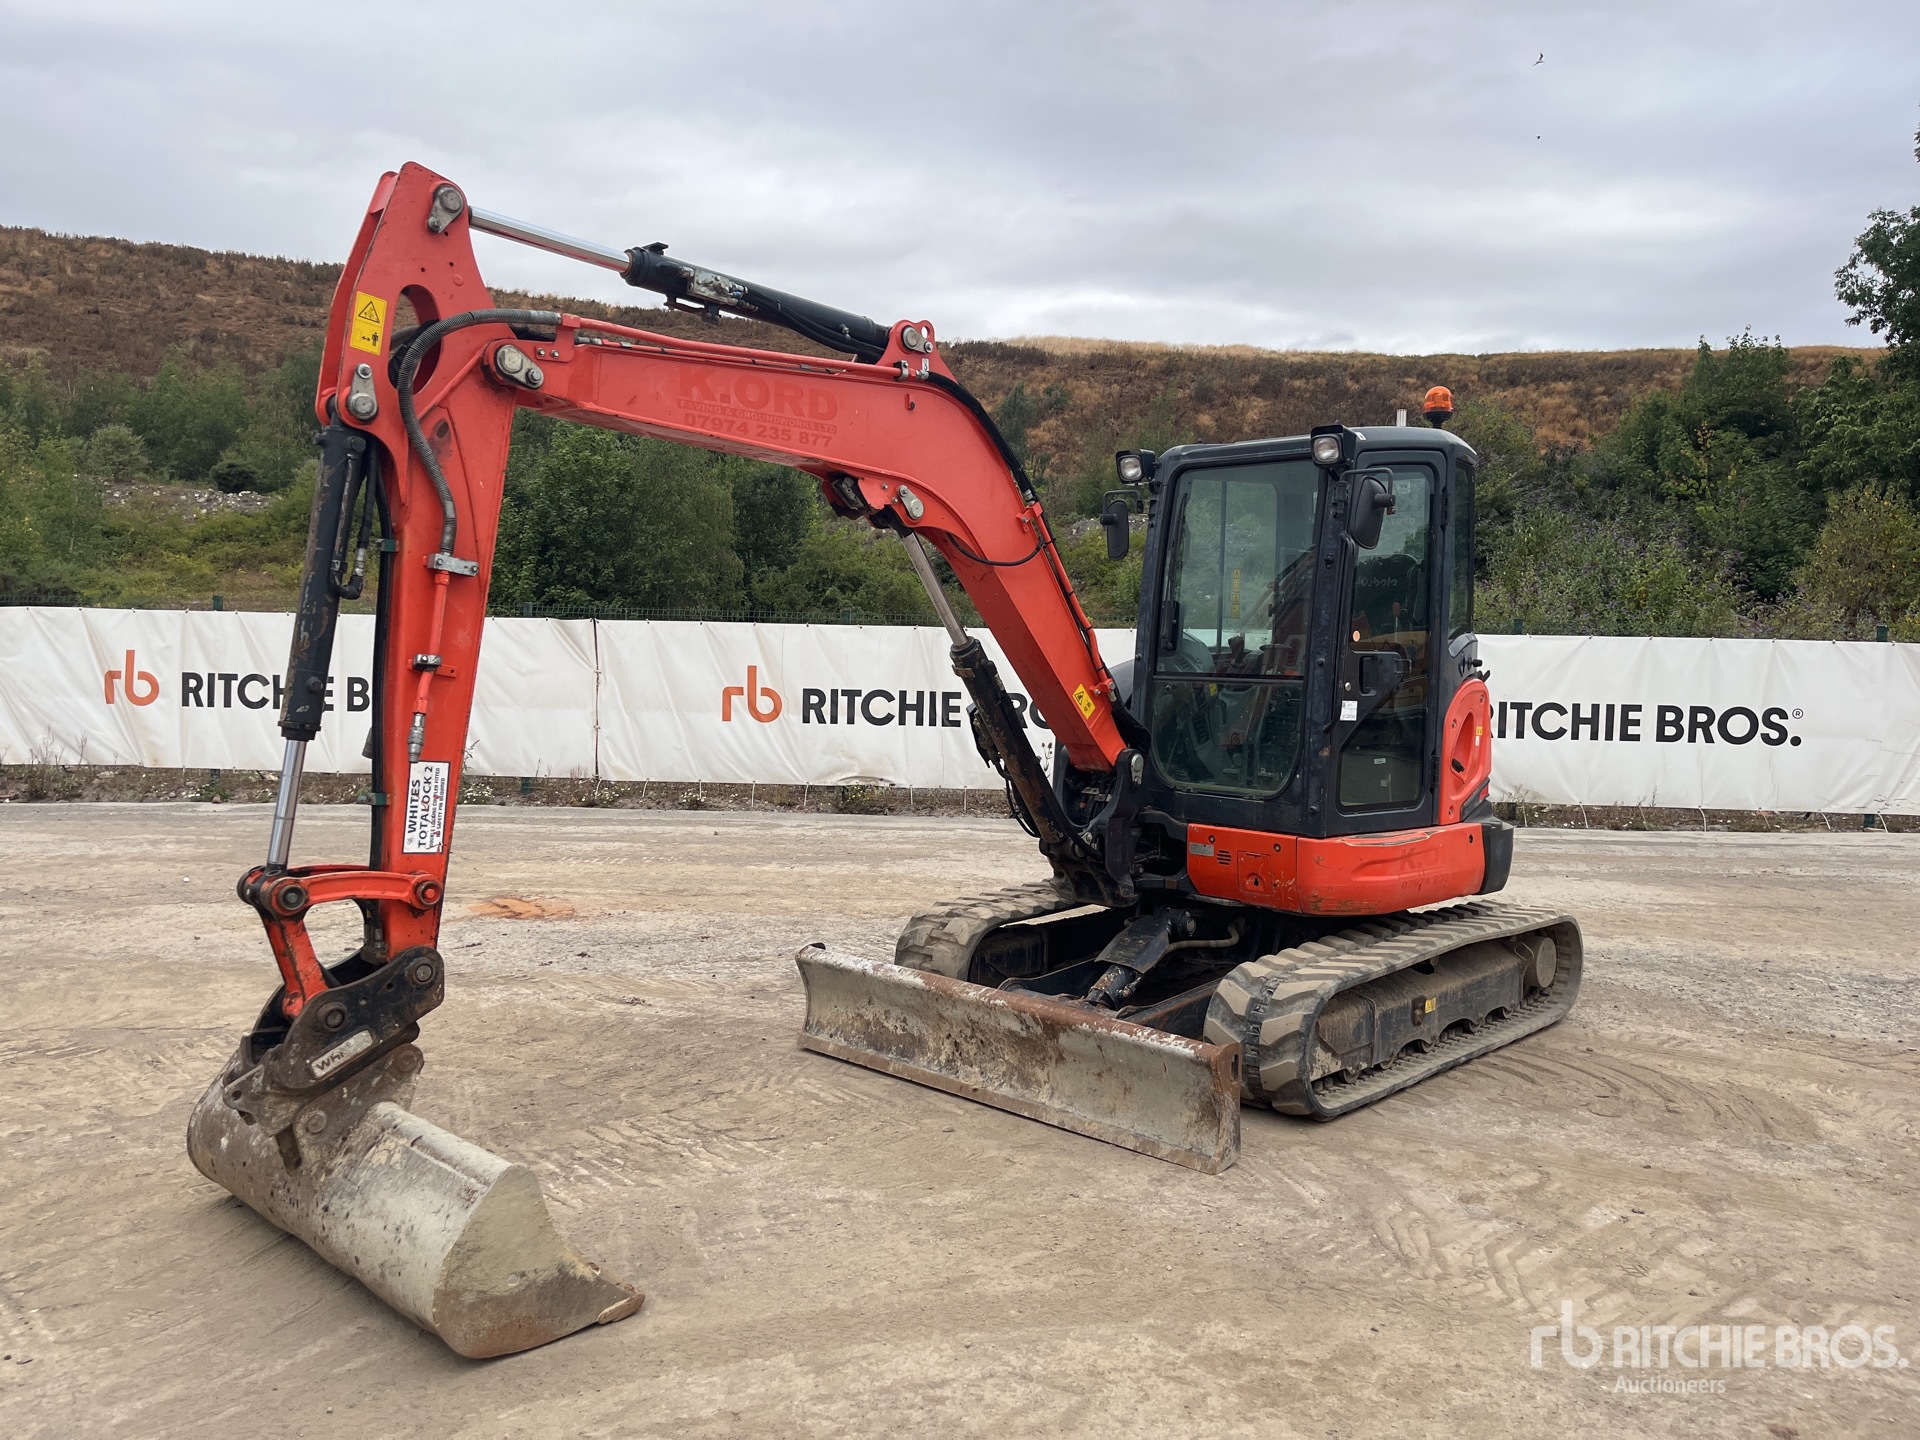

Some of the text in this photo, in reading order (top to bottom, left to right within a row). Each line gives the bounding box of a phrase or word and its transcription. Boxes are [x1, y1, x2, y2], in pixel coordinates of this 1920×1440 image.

[679, 367, 838, 421] K.ORD
[681, 401, 836, 433] PAVING & GROUNDWORKS LTD
[684, 413, 832, 448] 07974 235 877
[802, 688, 962, 728] RITCHIE
[408, 780, 421, 833] WHITES
[418, 776, 432, 848] TOTALOCK
